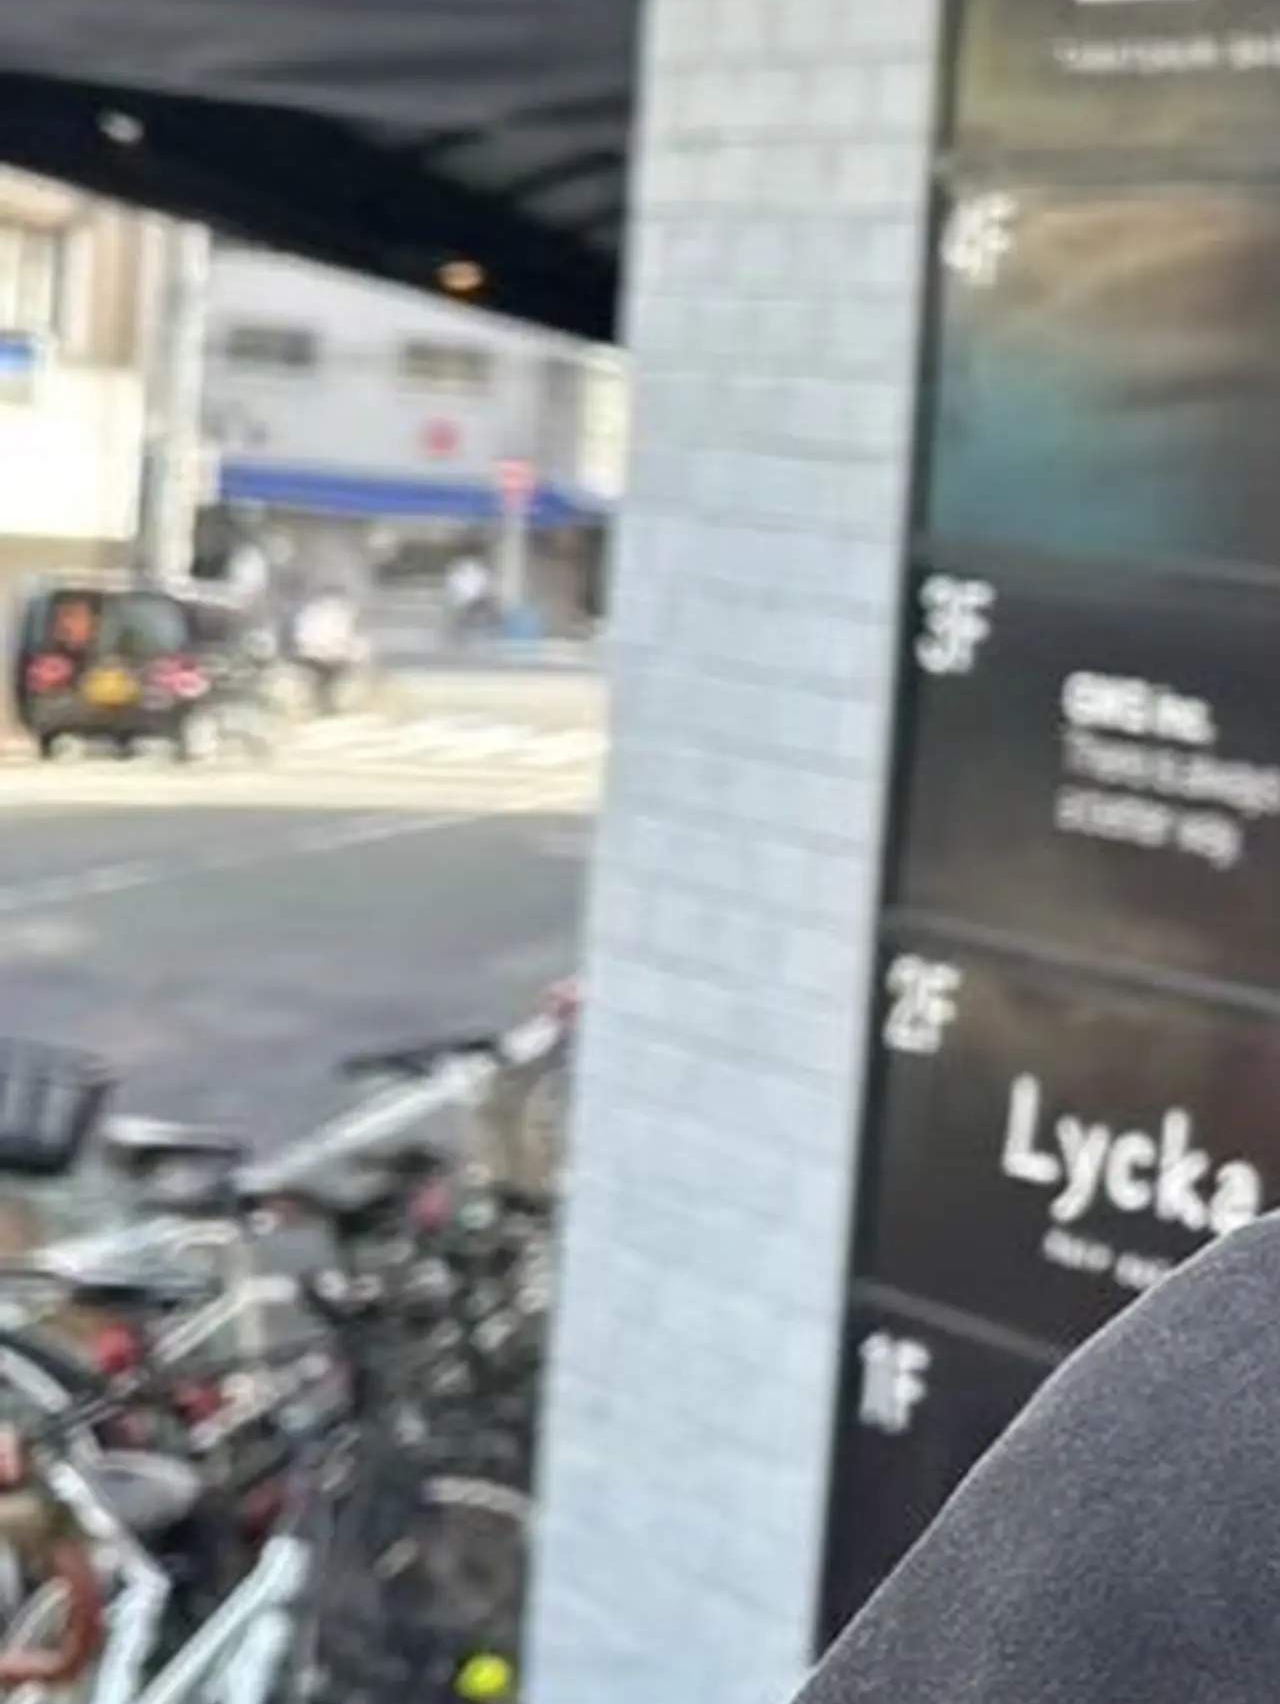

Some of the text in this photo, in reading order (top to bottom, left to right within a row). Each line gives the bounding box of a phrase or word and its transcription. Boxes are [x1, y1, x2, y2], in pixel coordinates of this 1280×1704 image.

[915, 573, 996, 673] 3F
[885, 954, 963, 1053] 2F
[1002, 1073, 1262, 1235] Lycka
[858, 1332, 932, 1433] 1F
